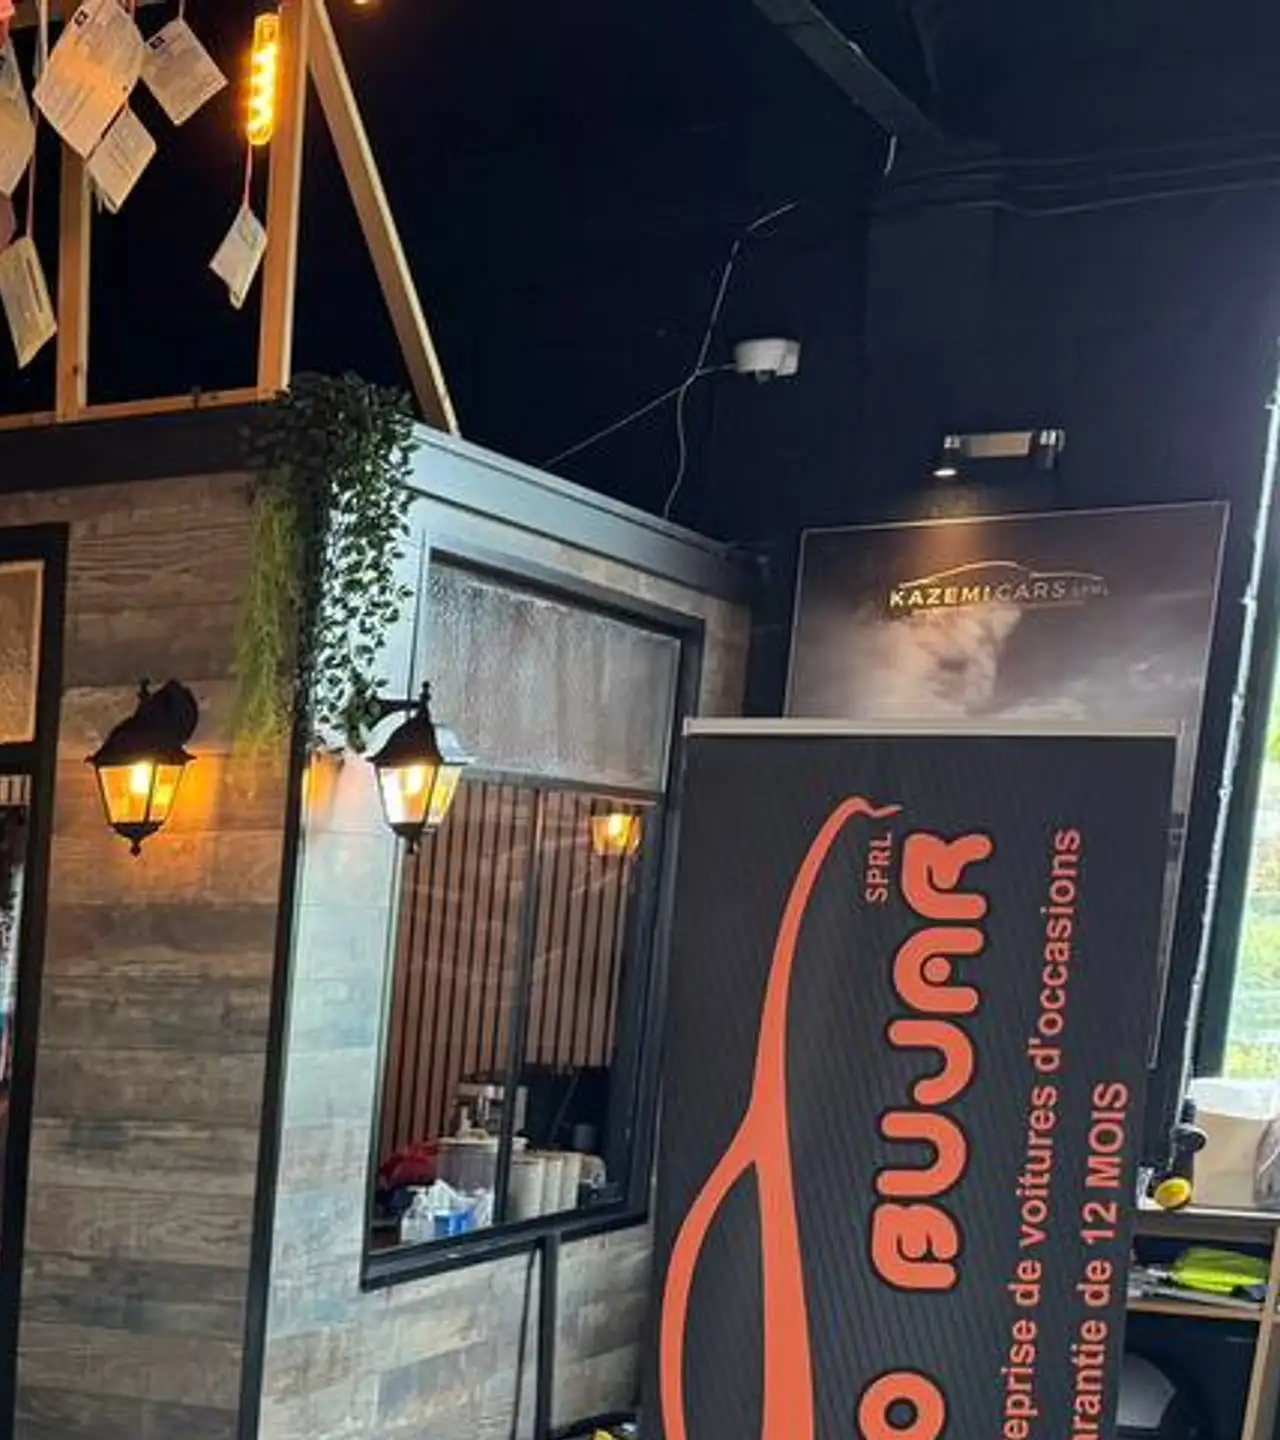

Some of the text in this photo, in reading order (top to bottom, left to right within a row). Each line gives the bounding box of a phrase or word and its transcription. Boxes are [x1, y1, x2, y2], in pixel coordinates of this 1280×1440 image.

[889, 579, 1067, 608] KAZEMICARS
[864, 831, 893, 904] SPRL
[1027, 828, 1081, 1073] d'occasions
[869, 829, 994, 1293] BUJAR
[1016, 1085, 1058, 1248] voitures
[1085, 1082, 1130, 1189] MOIS
[1080, 1200, 1118, 1246] 12
[1008, 1258, 1042, 1307] de
[1077, 1258, 1112, 1307] de
